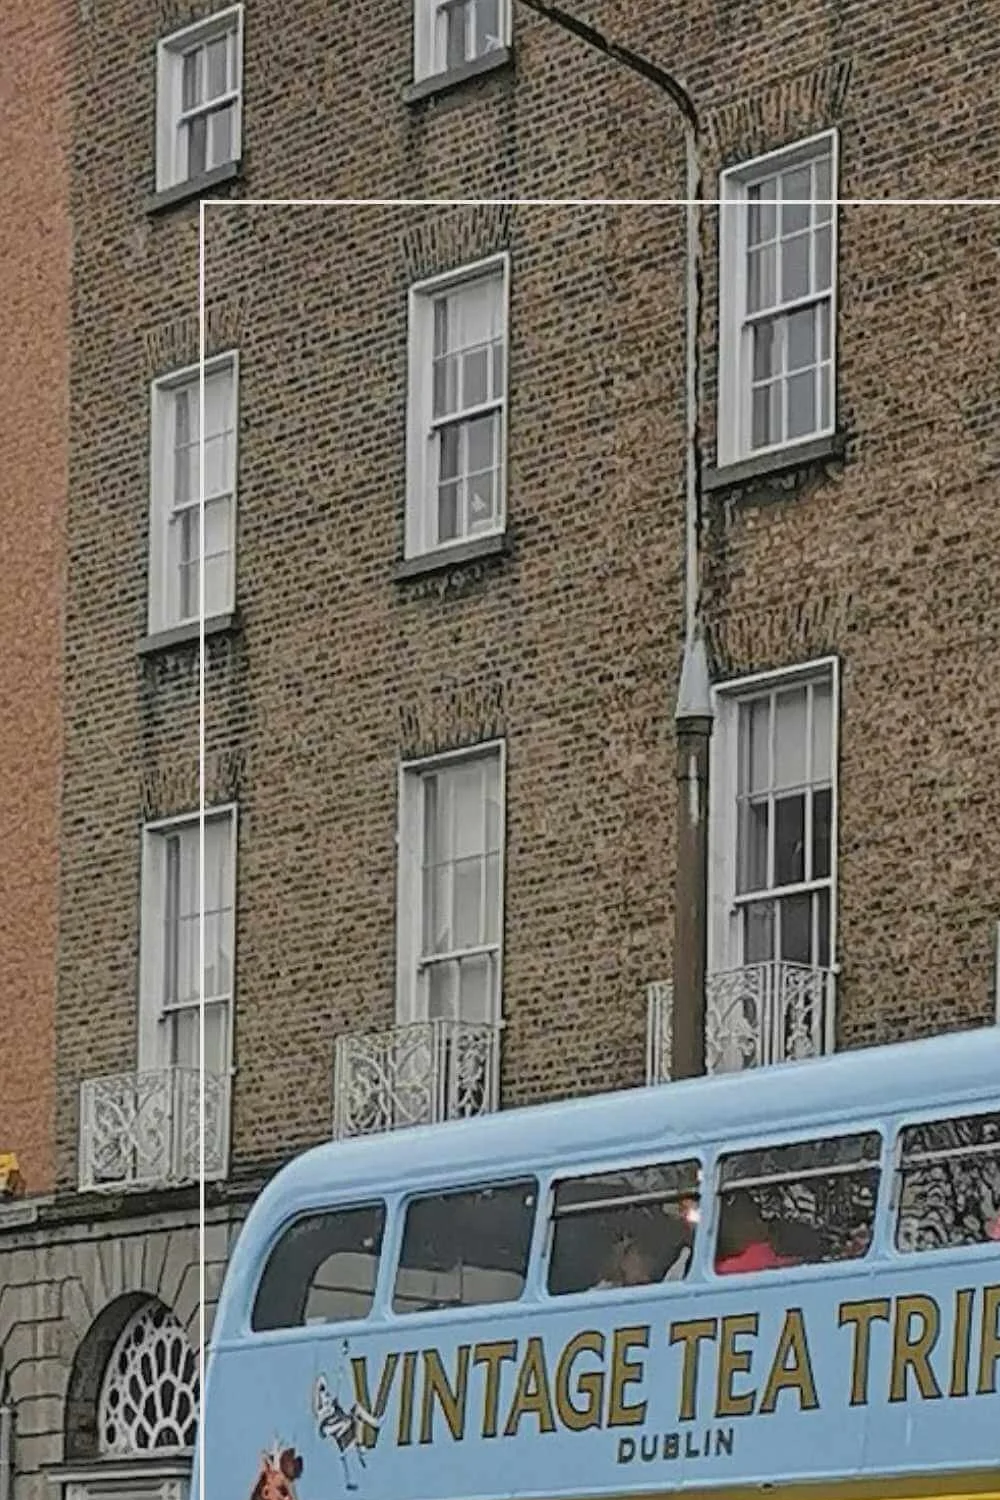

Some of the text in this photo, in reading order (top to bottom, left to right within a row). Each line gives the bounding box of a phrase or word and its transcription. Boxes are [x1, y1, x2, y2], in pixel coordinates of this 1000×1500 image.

[350, 1325, 651, 1449] VINTAGE
[669, 1307, 820, 1422] TEA
[616, 1428, 736, 1464] DUBLIN
